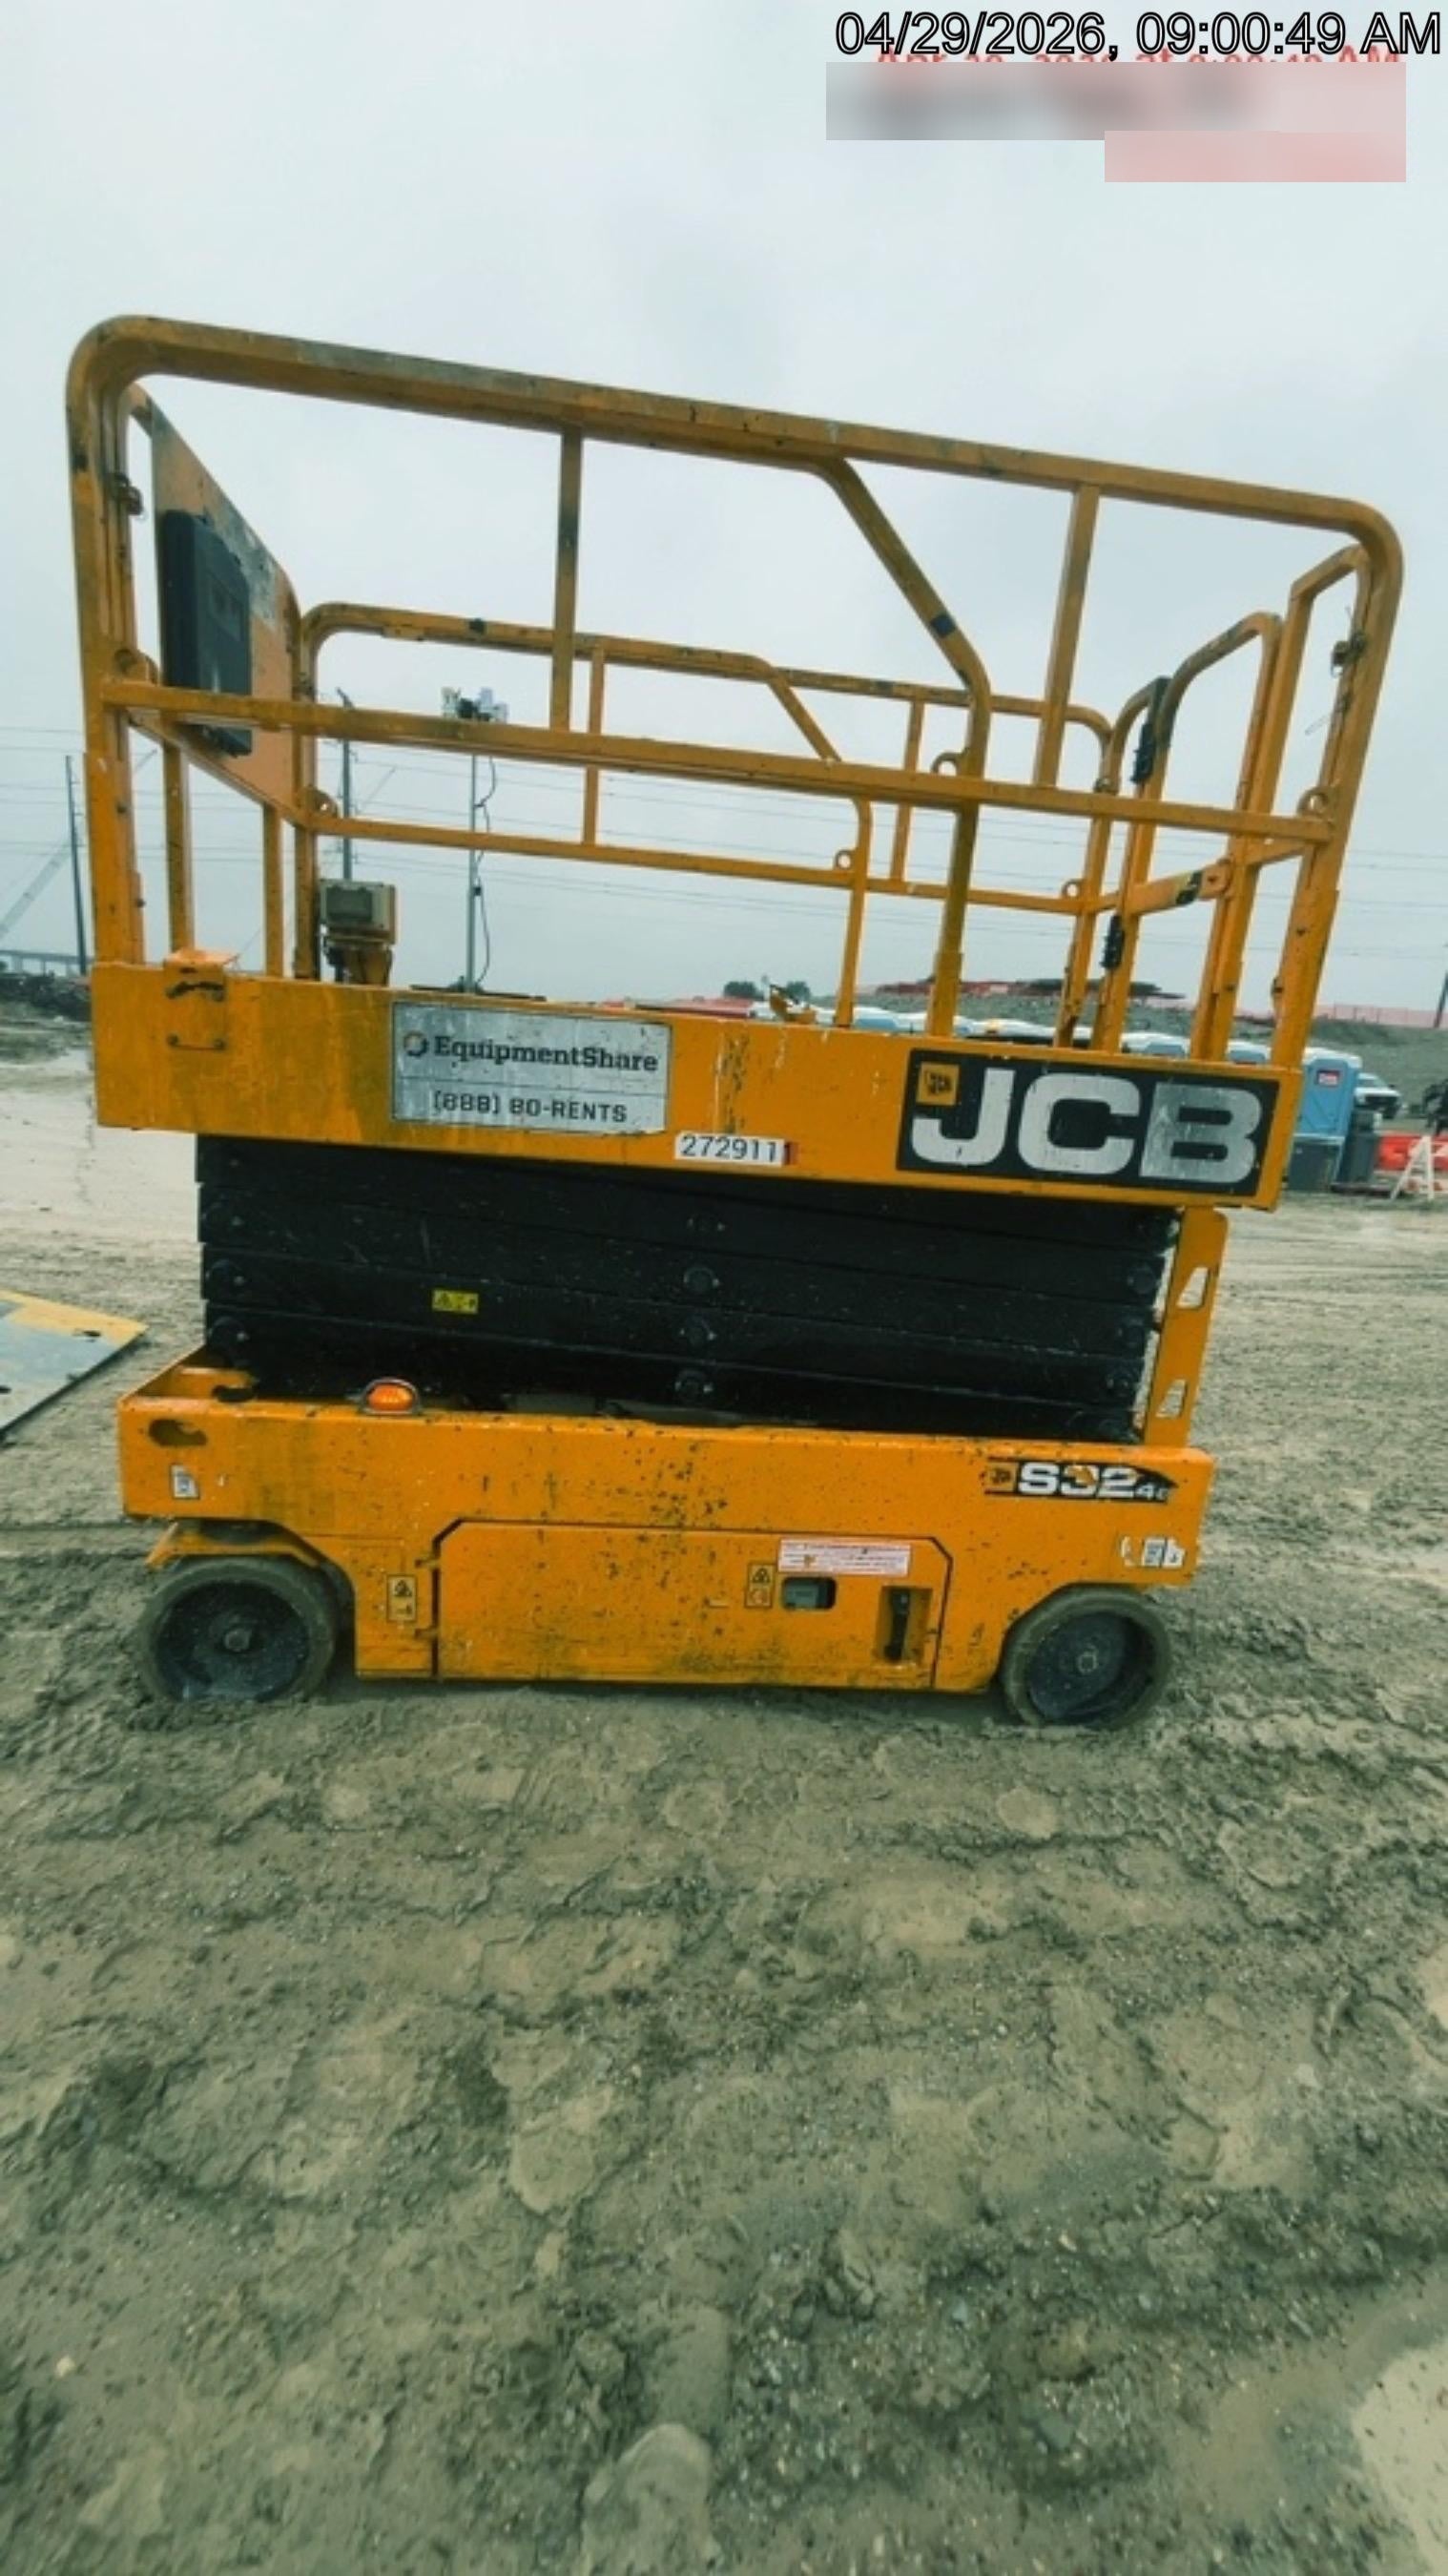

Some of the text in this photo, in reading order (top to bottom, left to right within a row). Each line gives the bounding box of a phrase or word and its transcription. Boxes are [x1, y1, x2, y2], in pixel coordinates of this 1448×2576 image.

[433, 1035, 659, 1072] EquipmentShare
[509, 1097, 628, 1124] 80-RENTS
[912, 1067, 1261, 1183] JCB
[681, 1134, 776, 1163] 272911
